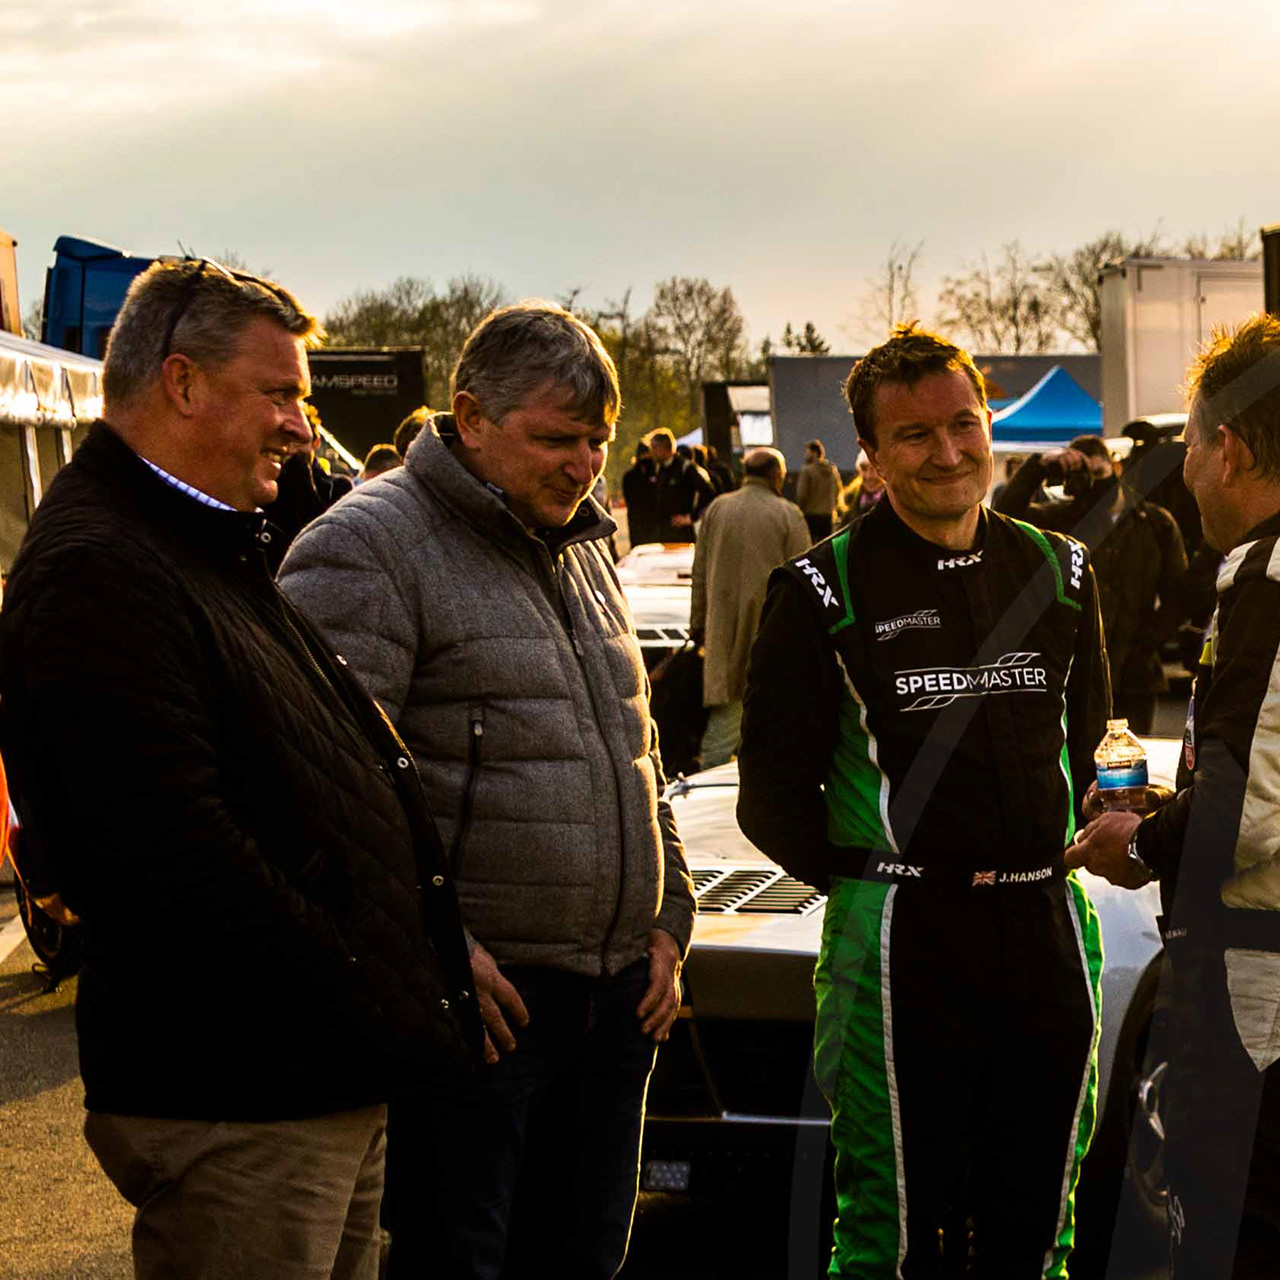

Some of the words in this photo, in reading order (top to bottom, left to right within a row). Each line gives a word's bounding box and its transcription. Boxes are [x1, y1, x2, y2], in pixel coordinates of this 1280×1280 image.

[937, 550, 983, 570] HRX
[795, 558, 839, 608] HRX
[895, 667, 1048, 695] SPEEDMASTER
[876, 862, 924, 877] HRX
[999, 866, 1053, 882] J.HANSON
